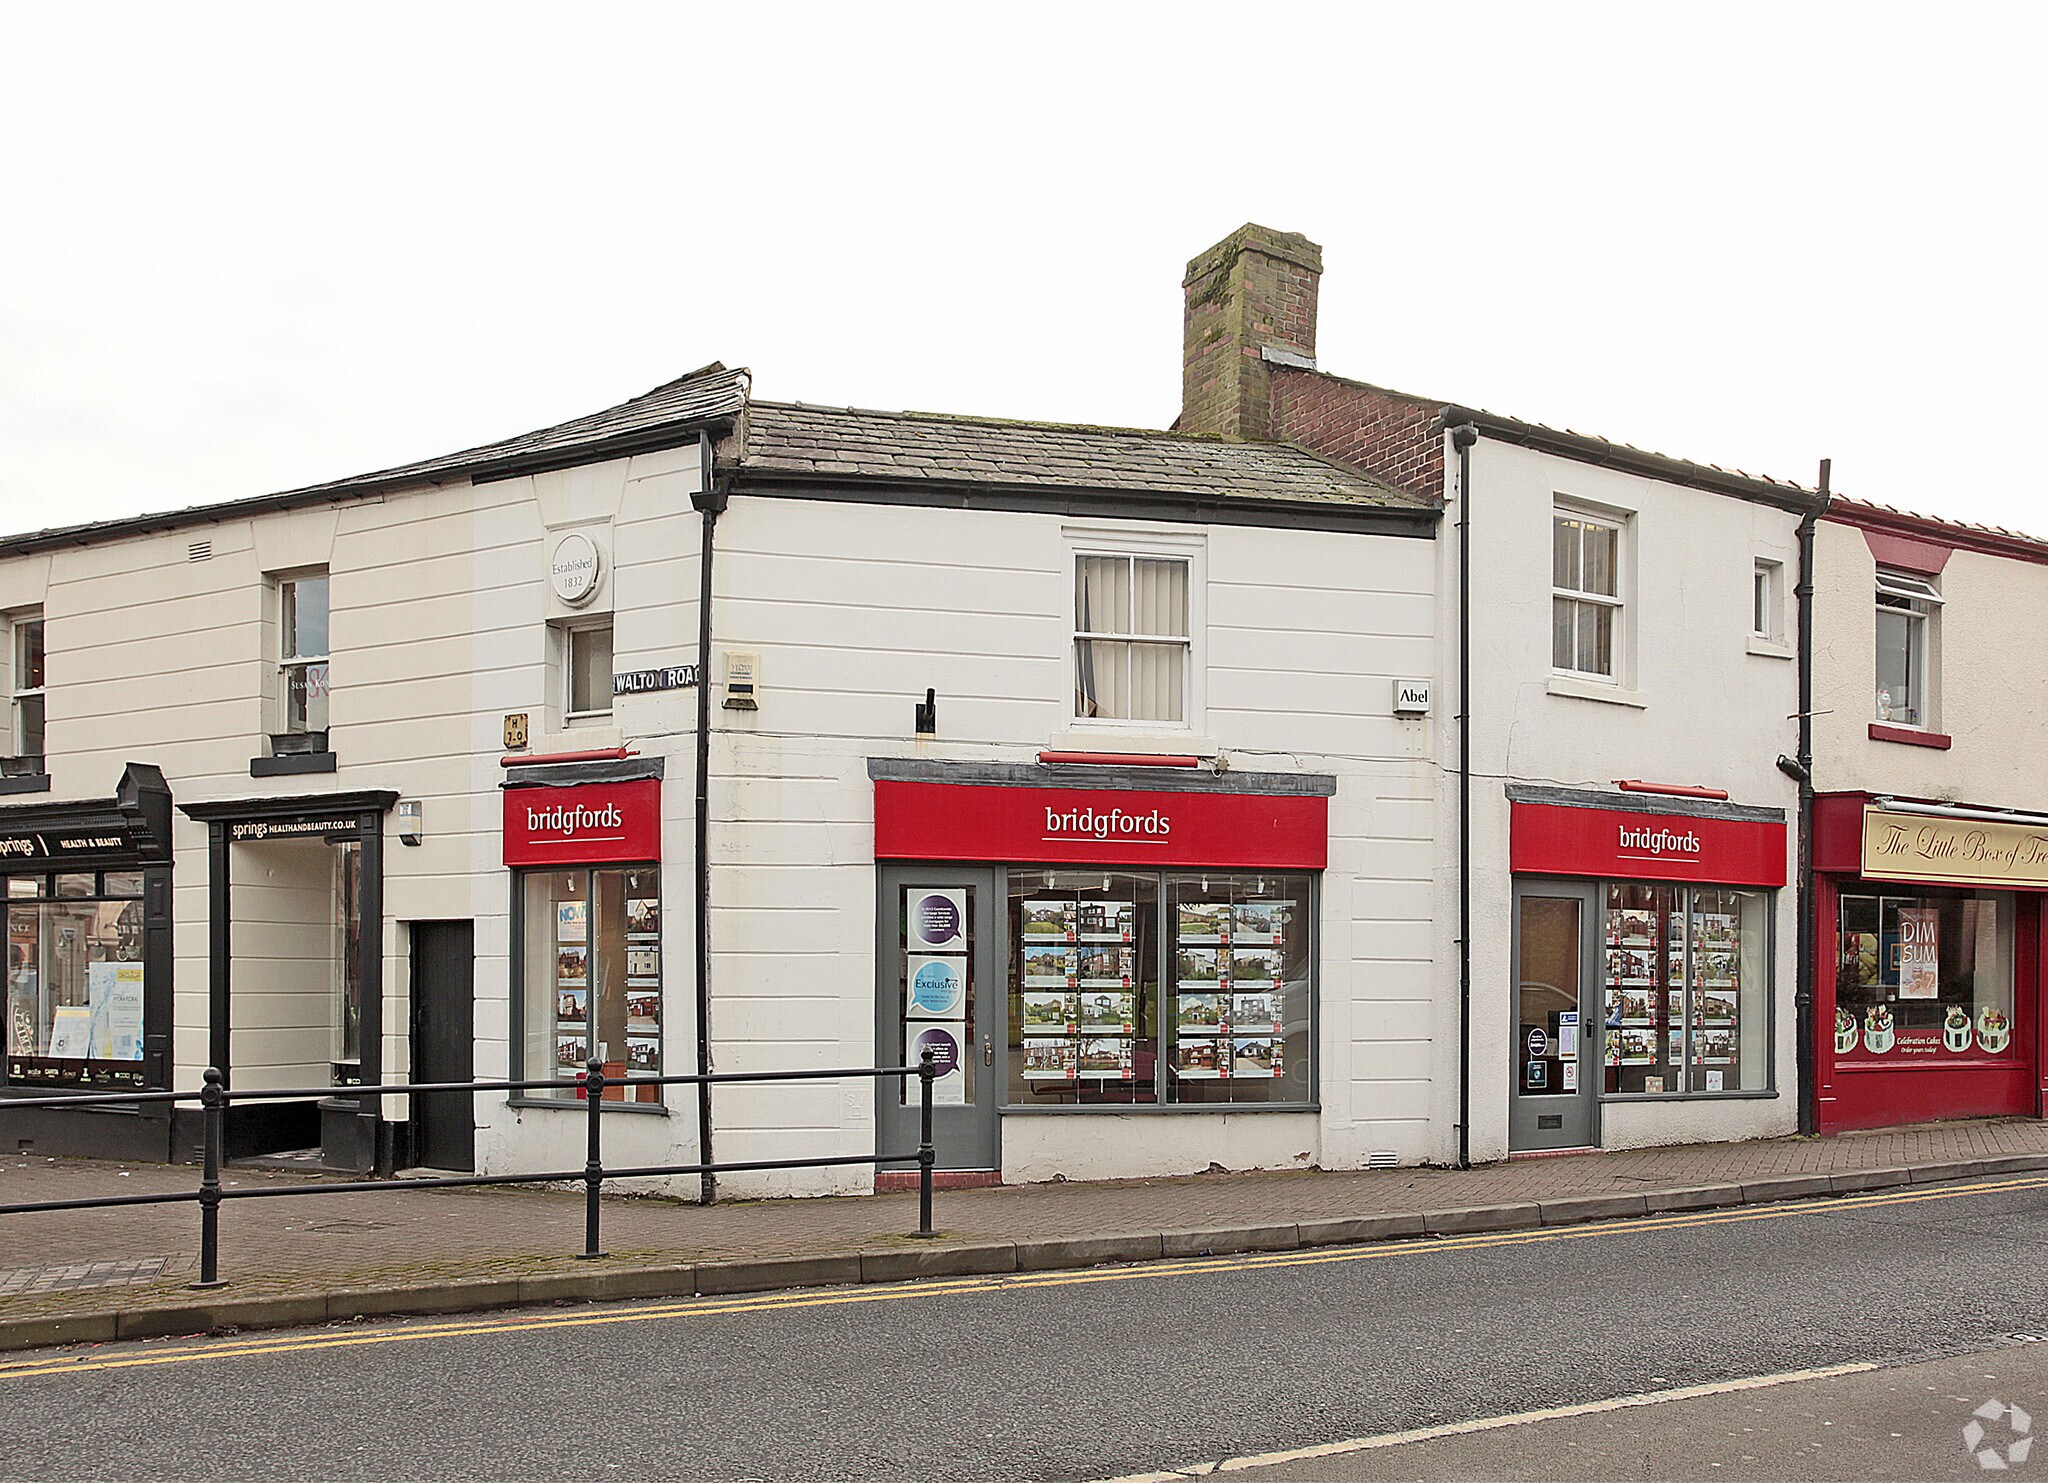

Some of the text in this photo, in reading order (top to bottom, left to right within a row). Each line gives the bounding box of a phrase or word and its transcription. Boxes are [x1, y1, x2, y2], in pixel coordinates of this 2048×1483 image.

[552, 557, 592, 575] Established
[564, 575, 583, 588] 1832
[1400, 689, 1428, 703] Abel
[512, 719, 518, 728] H
[526, 802, 623, 835] bridgfords
[1045, 806, 1170, 839] bridgfords
[232, 820, 357, 840] springs HEALTHANDBEAUTY.CO.UK
[1618, 825, 1700, 854] bridgfords
[0, 836, 35, 857] prings
[60, 837, 123, 849] HEALTH & BEAUTY
[1876, 823, 1910, 855] The
[1913, 825, 1959, 860] Little
[1962, 829, 2003, 862] Box
[2003, 839, 2024, 873] of
[1901, 921, 1935, 944] DIM
[1902, 944, 1936, 963] SUM
[915, 978, 958, 989] Exclusive
[1896, 1035, 1941, 1045] Celebration Cakes
